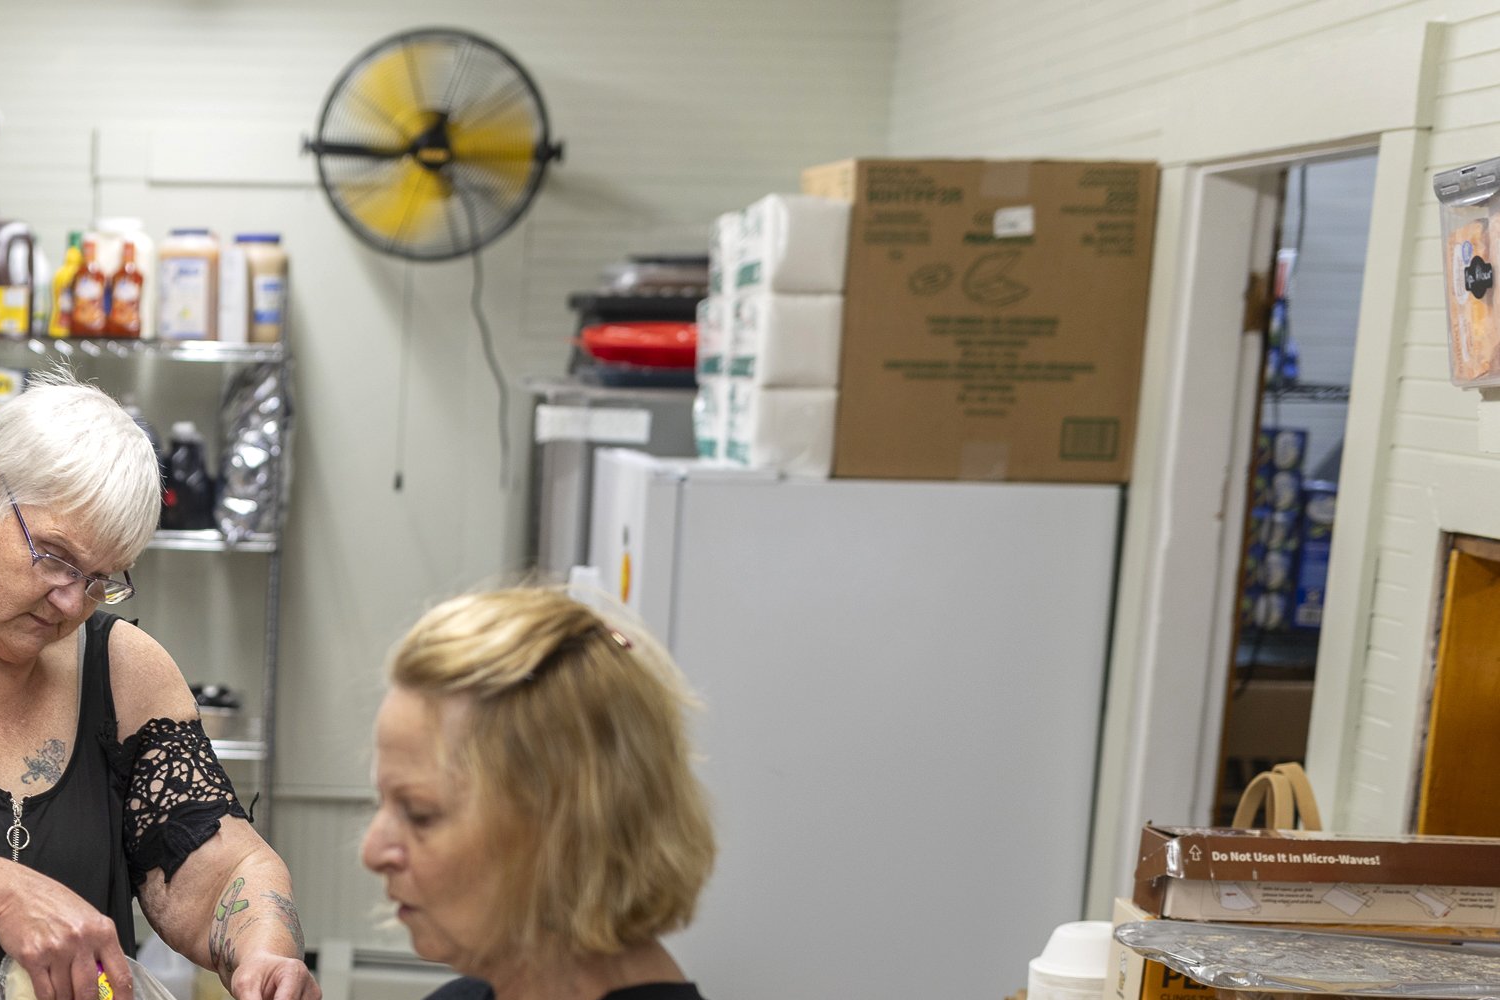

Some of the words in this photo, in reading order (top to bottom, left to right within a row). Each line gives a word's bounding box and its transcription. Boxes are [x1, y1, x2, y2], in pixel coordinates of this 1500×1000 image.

[1211, 851, 1228, 862] Do
[1230, 852, 1252, 863] Not
[1253, 852, 1275, 863] Use
[1277, 852, 1288, 863] It
[1302, 853, 1381, 866] Micro-Waves!
